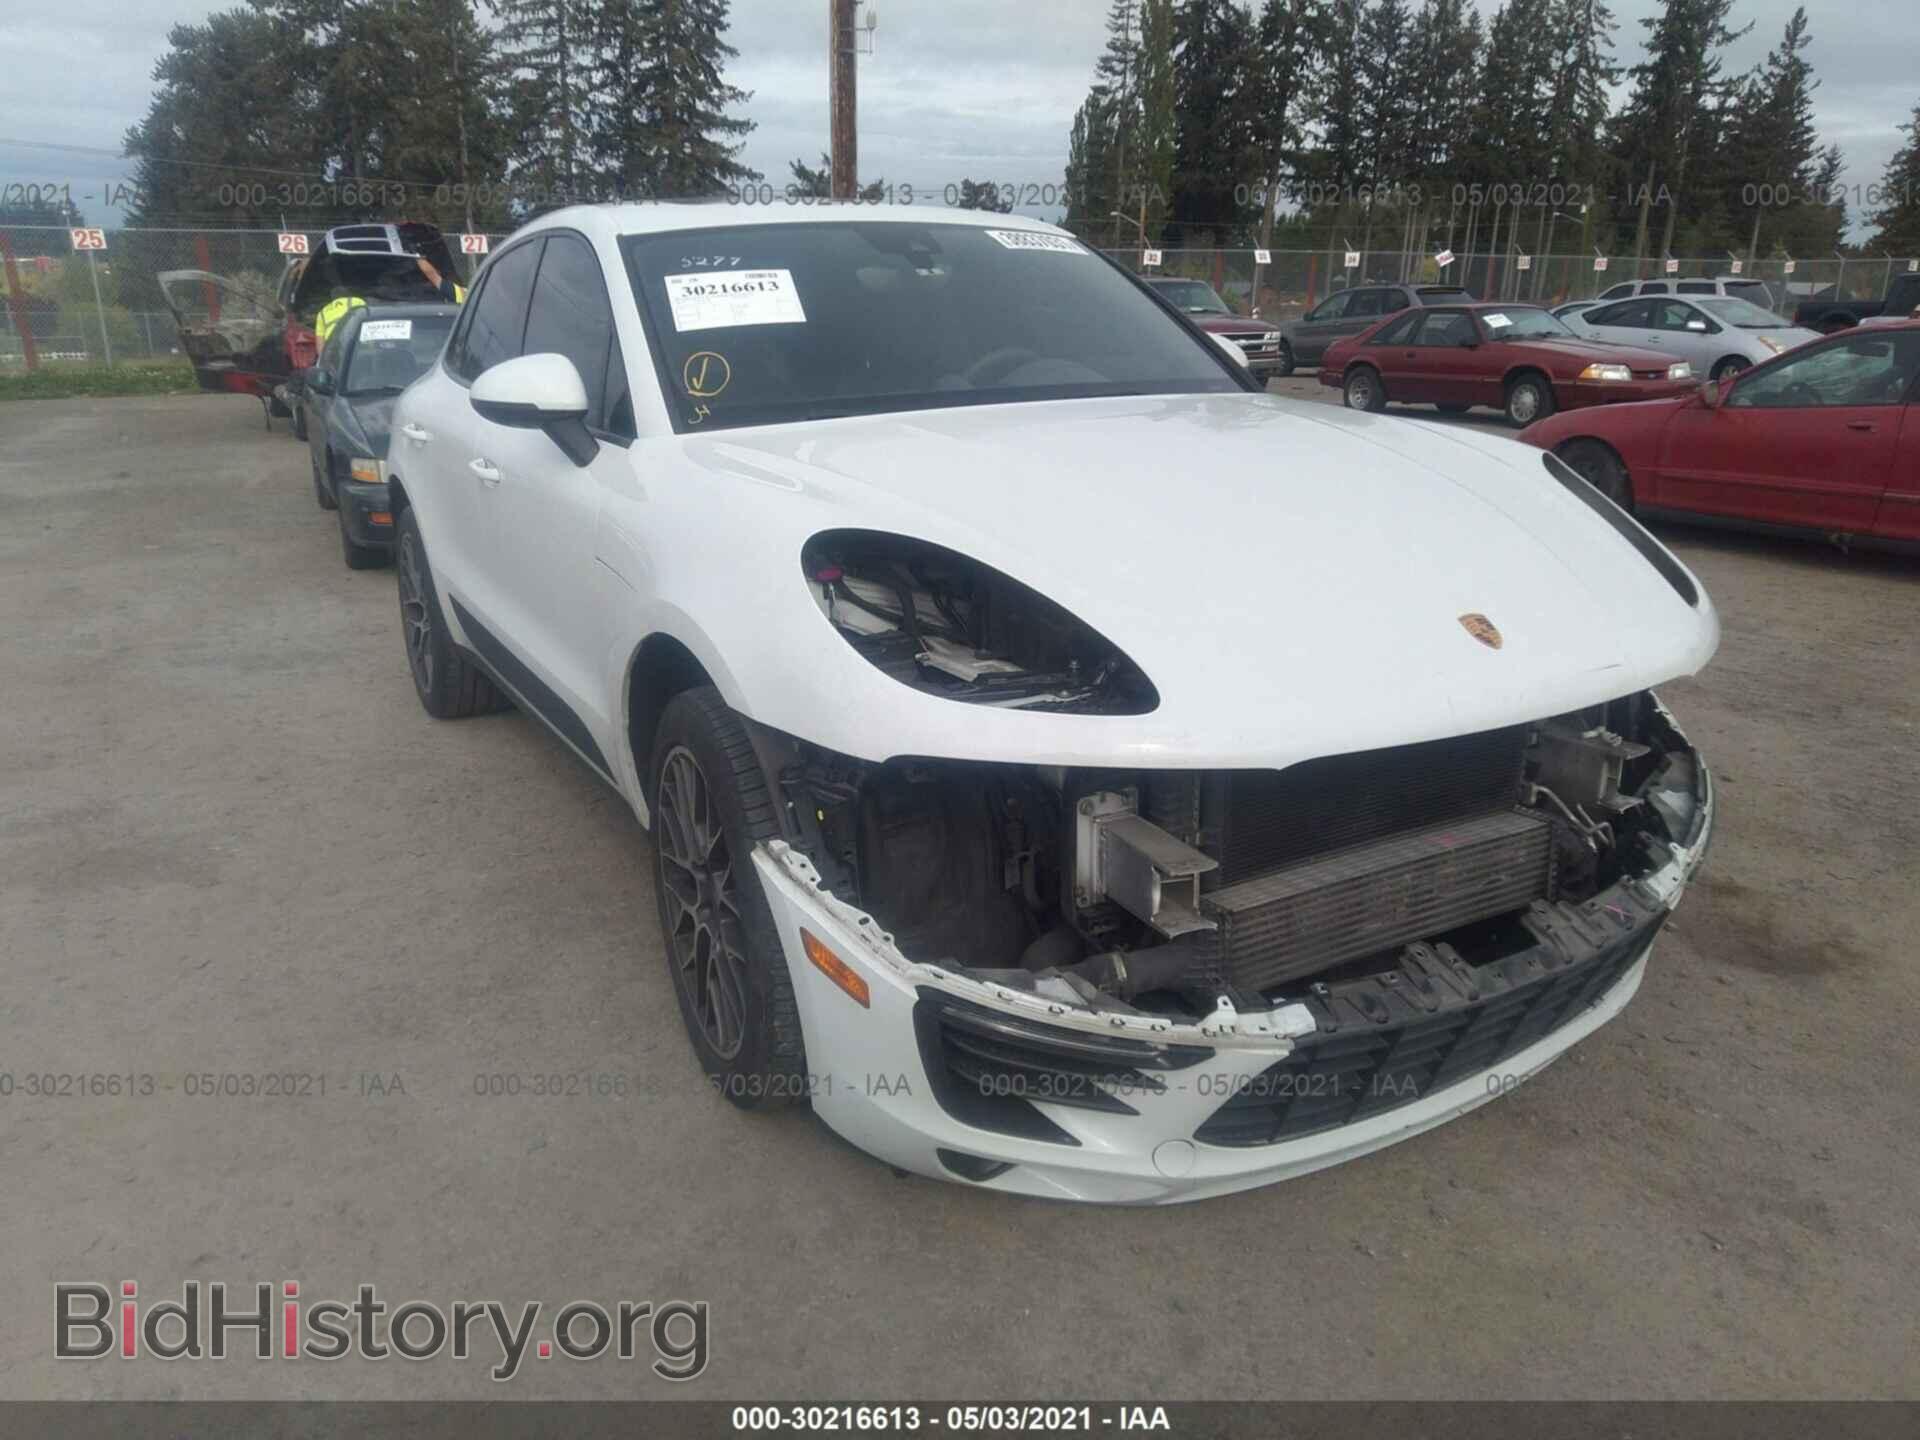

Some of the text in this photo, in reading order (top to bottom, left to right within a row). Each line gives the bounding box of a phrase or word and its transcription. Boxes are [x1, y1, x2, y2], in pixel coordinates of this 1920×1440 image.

[74, 230, 103, 248] 25
[281, 235, 305, 252] 26
[464, 236, 484, 252] 27
[682, 280, 780, 297] 30216613
